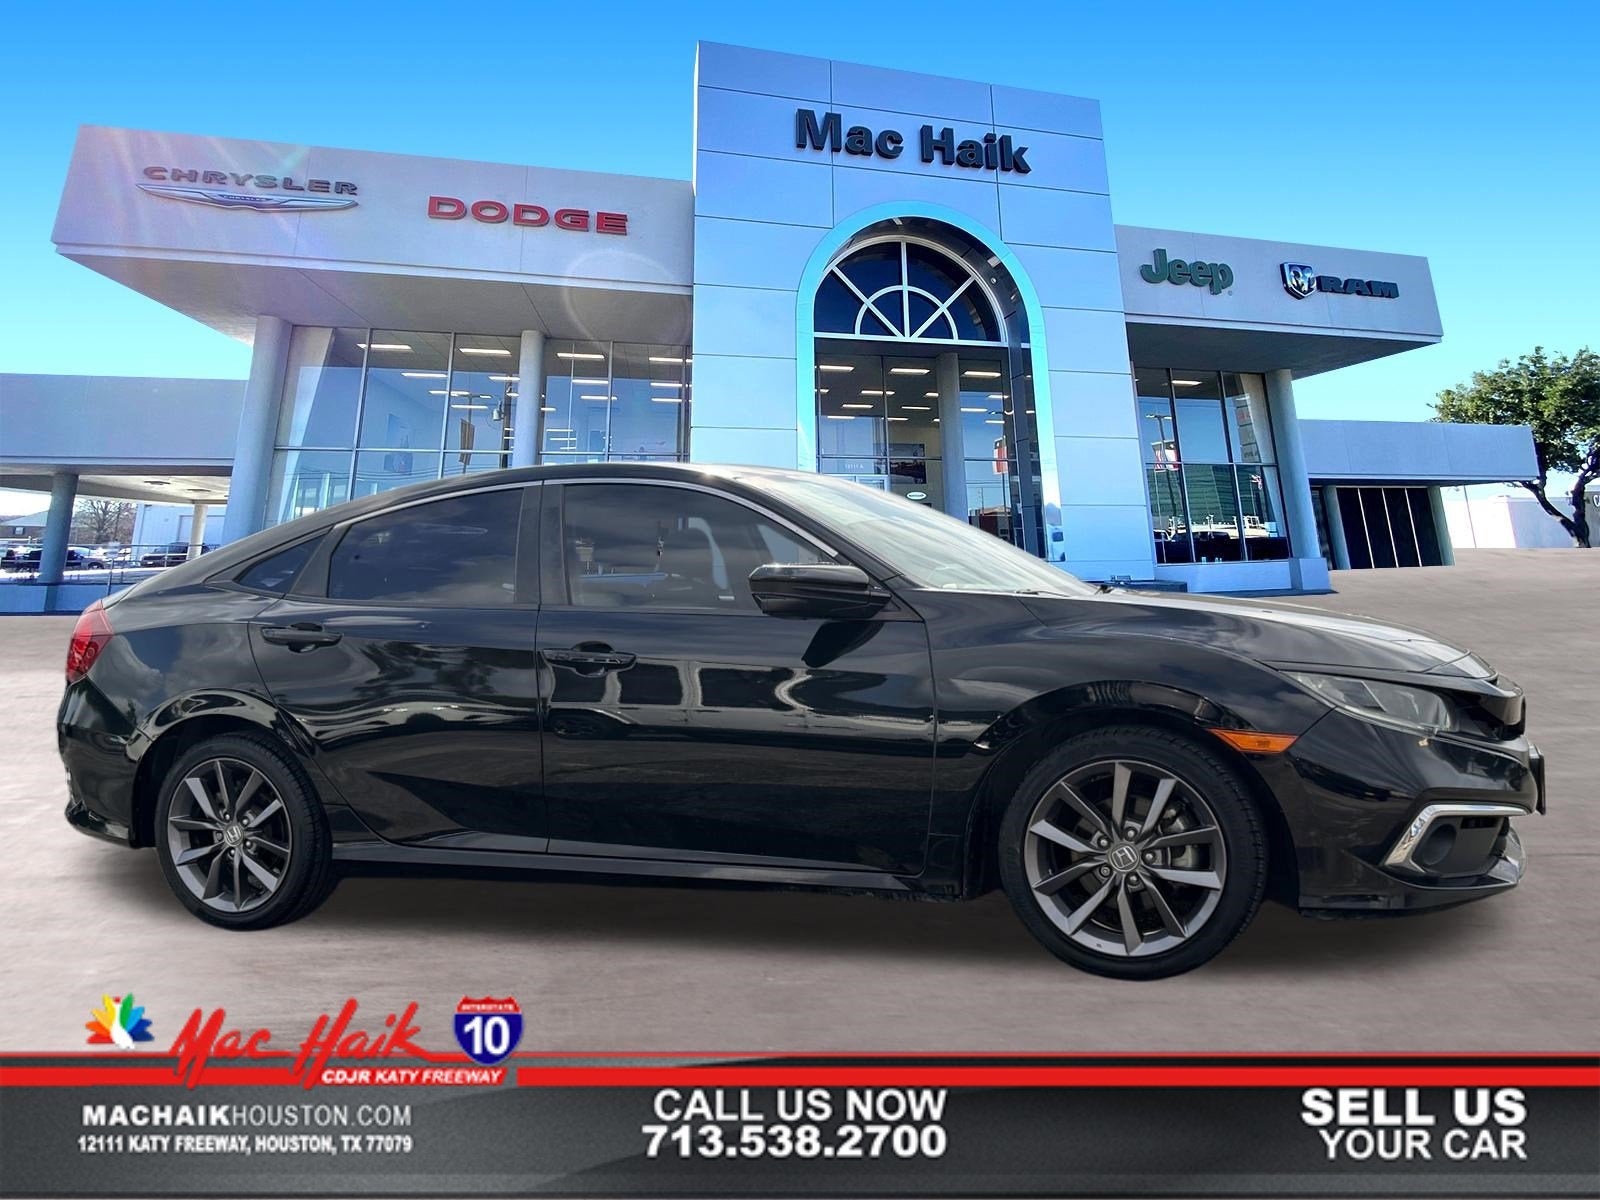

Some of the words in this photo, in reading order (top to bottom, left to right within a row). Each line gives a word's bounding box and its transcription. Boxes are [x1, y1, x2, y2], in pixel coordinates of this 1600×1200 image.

[795, 108, 904, 160] Mac
[920, 124, 1032, 174] Haik
[143, 166, 358, 196] CHRYSLER
[428, 196, 628, 236] DODGE
[1140, 248, 1234, 296] Jeep
[1315, 275, 1400, 299] RAM
